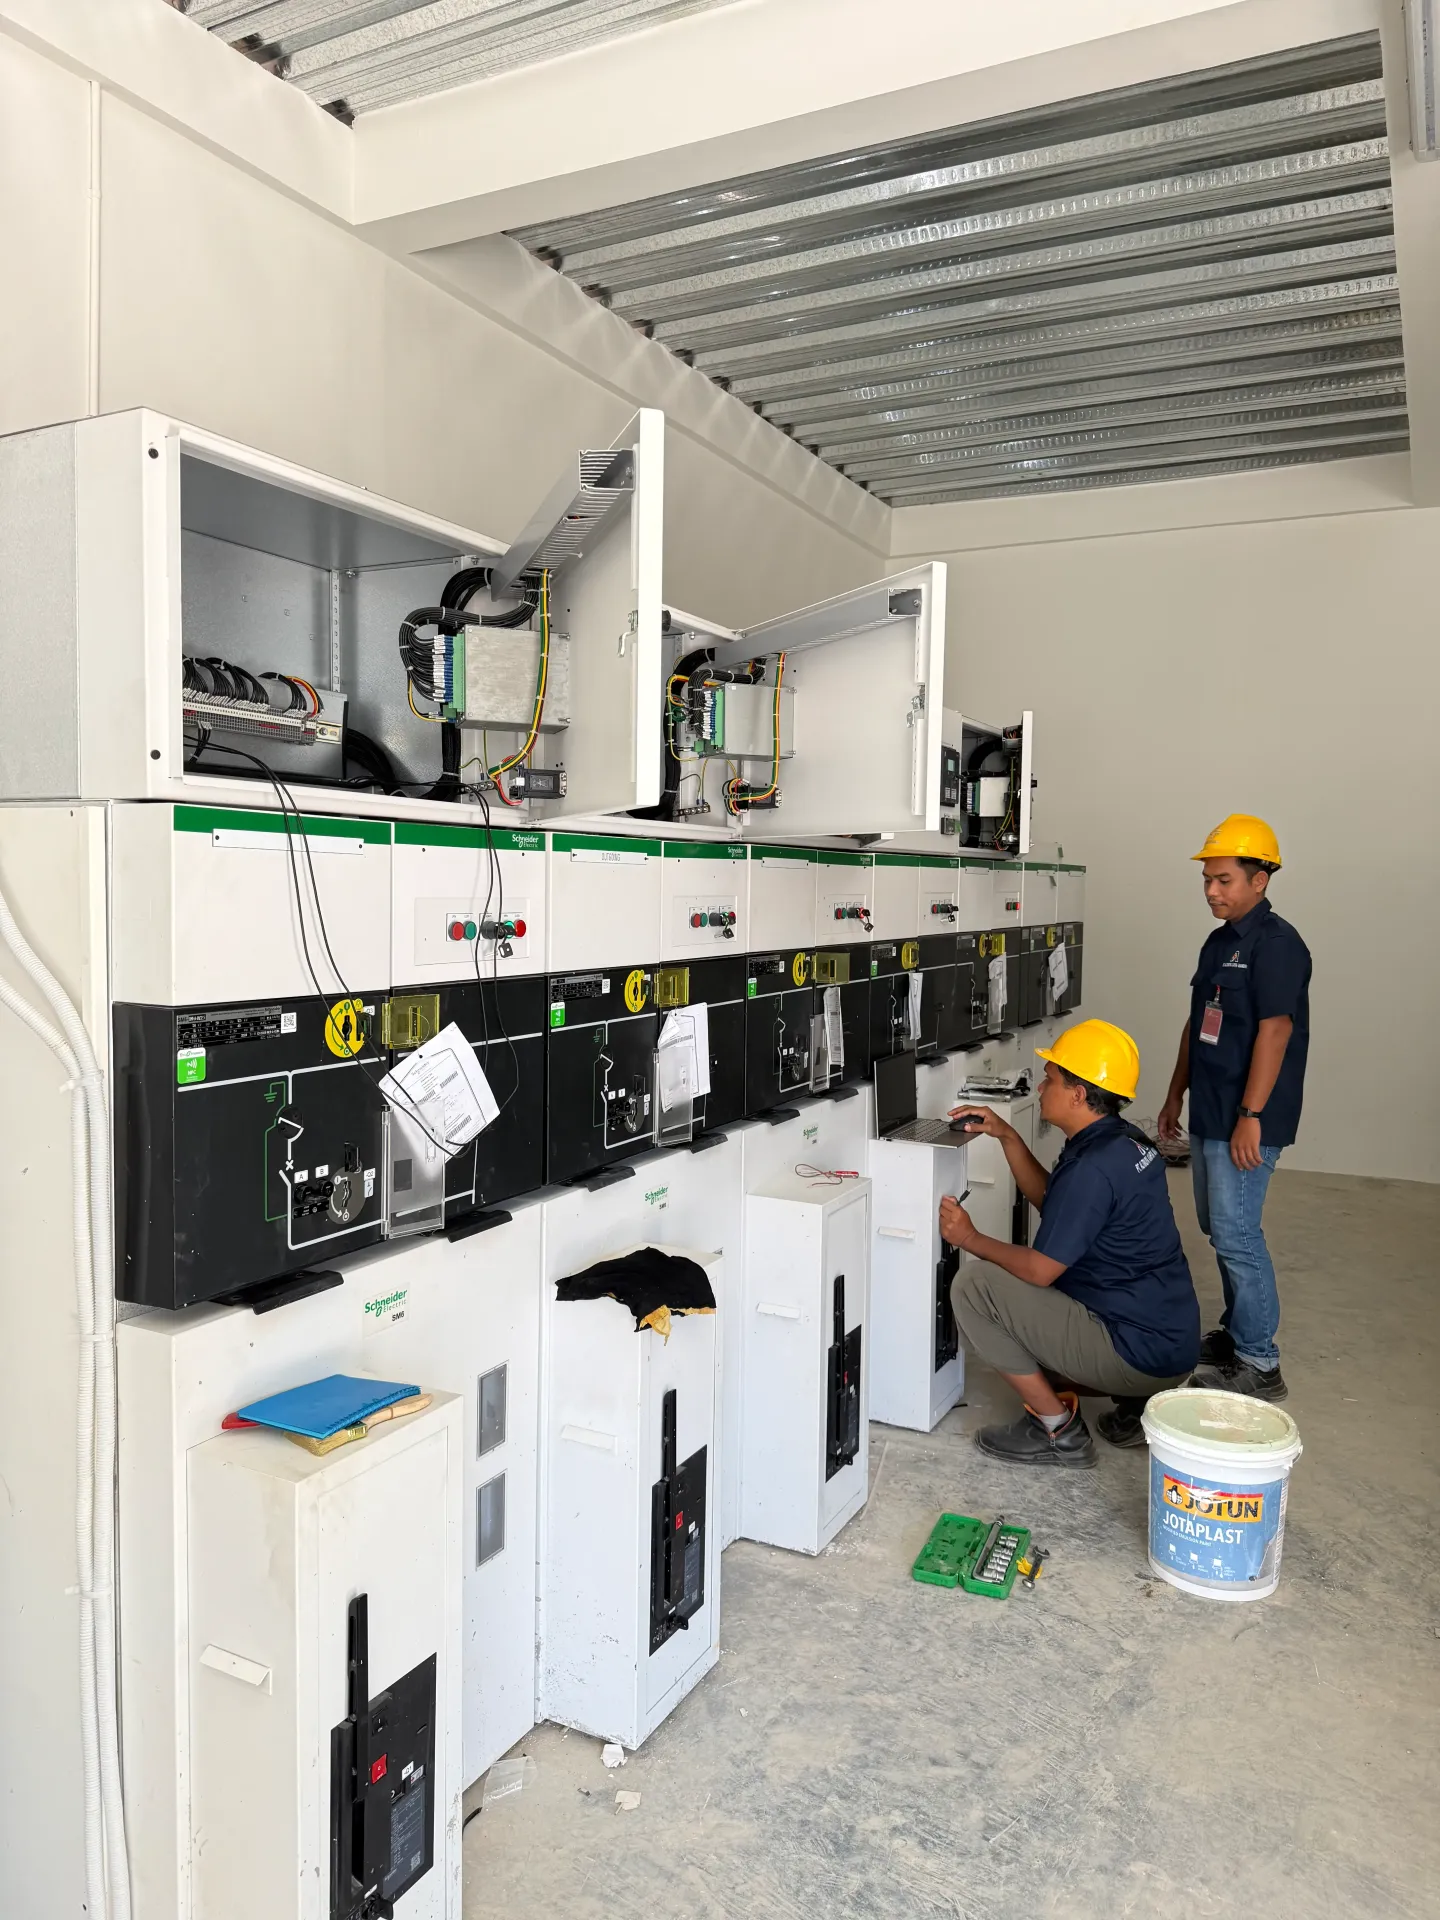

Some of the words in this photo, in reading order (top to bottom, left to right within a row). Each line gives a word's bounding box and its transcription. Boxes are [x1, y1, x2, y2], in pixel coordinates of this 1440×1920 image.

[364, 1289, 408, 1318] Schneider
[383, 1299, 407, 1313] Electric
[1184, 1493, 1259, 1518] JOTUN
[1162, 1511, 1244, 1545] JOTAPLAST
